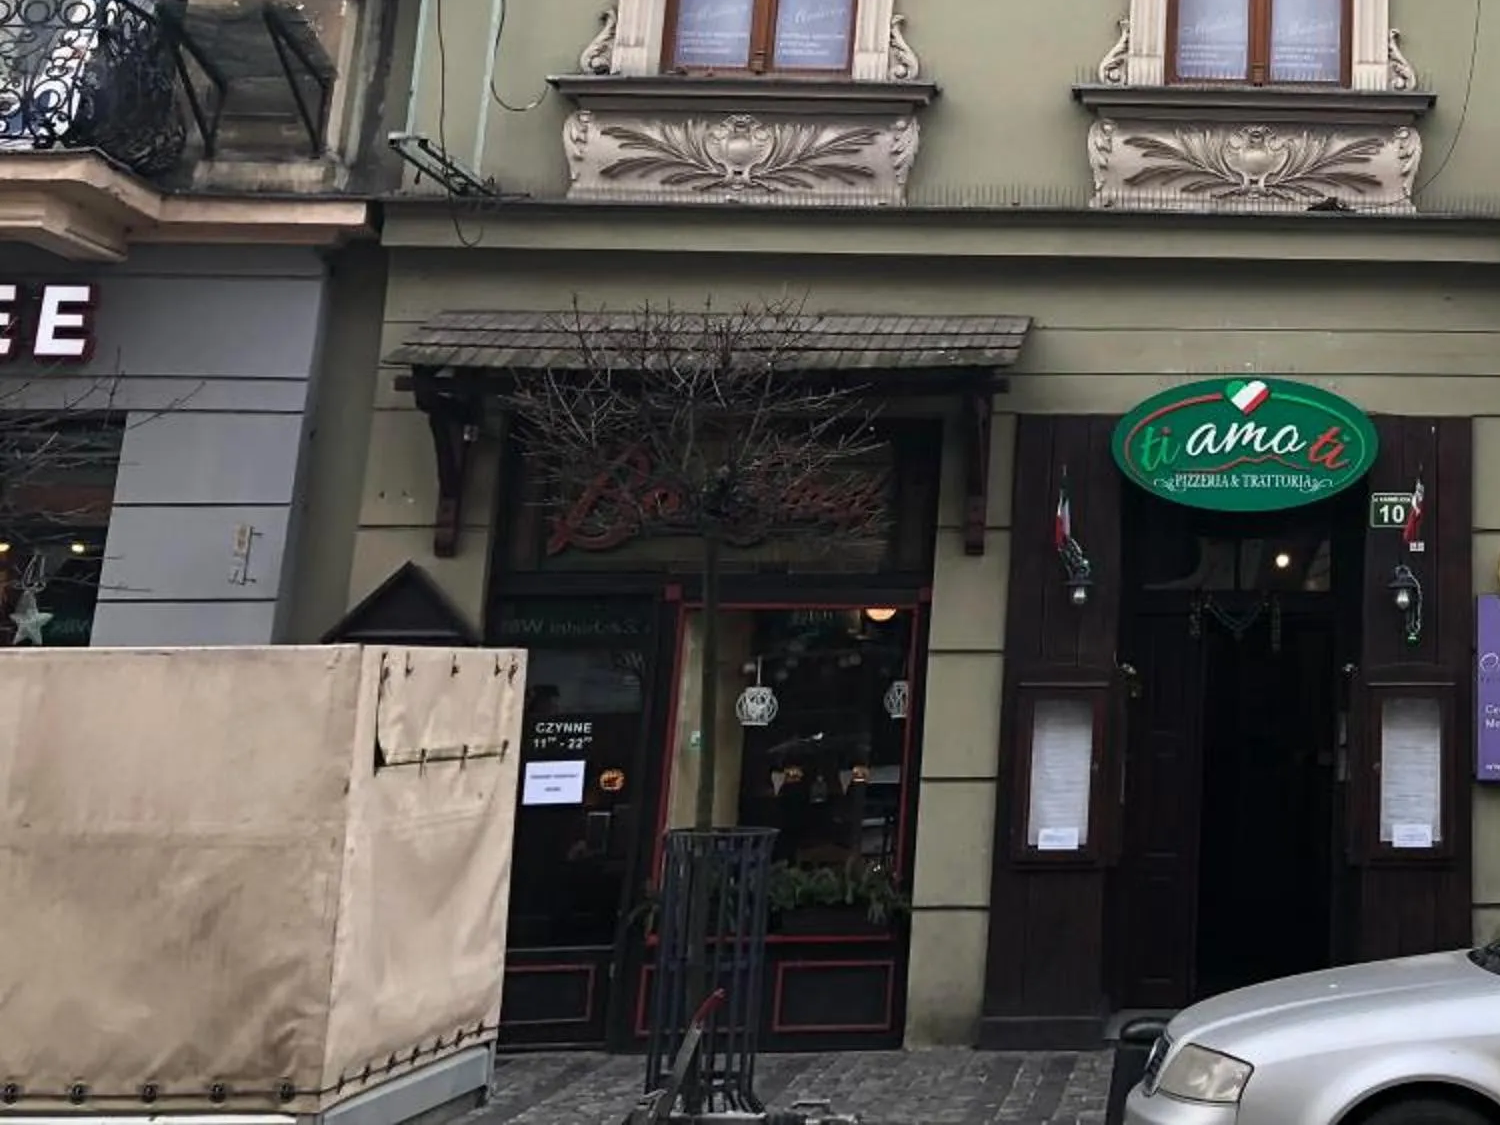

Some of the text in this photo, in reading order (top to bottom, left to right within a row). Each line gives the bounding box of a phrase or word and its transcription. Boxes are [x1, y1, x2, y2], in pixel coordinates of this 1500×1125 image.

[1185, 421, 1306, 457] amo
[1175, 474, 1229, 489] PIZZERIA
[1243, 474, 1312, 489] TRATTORIA
[1379, 504, 1405, 524] 10
[535, 722, 593, 734] CZYNNE
